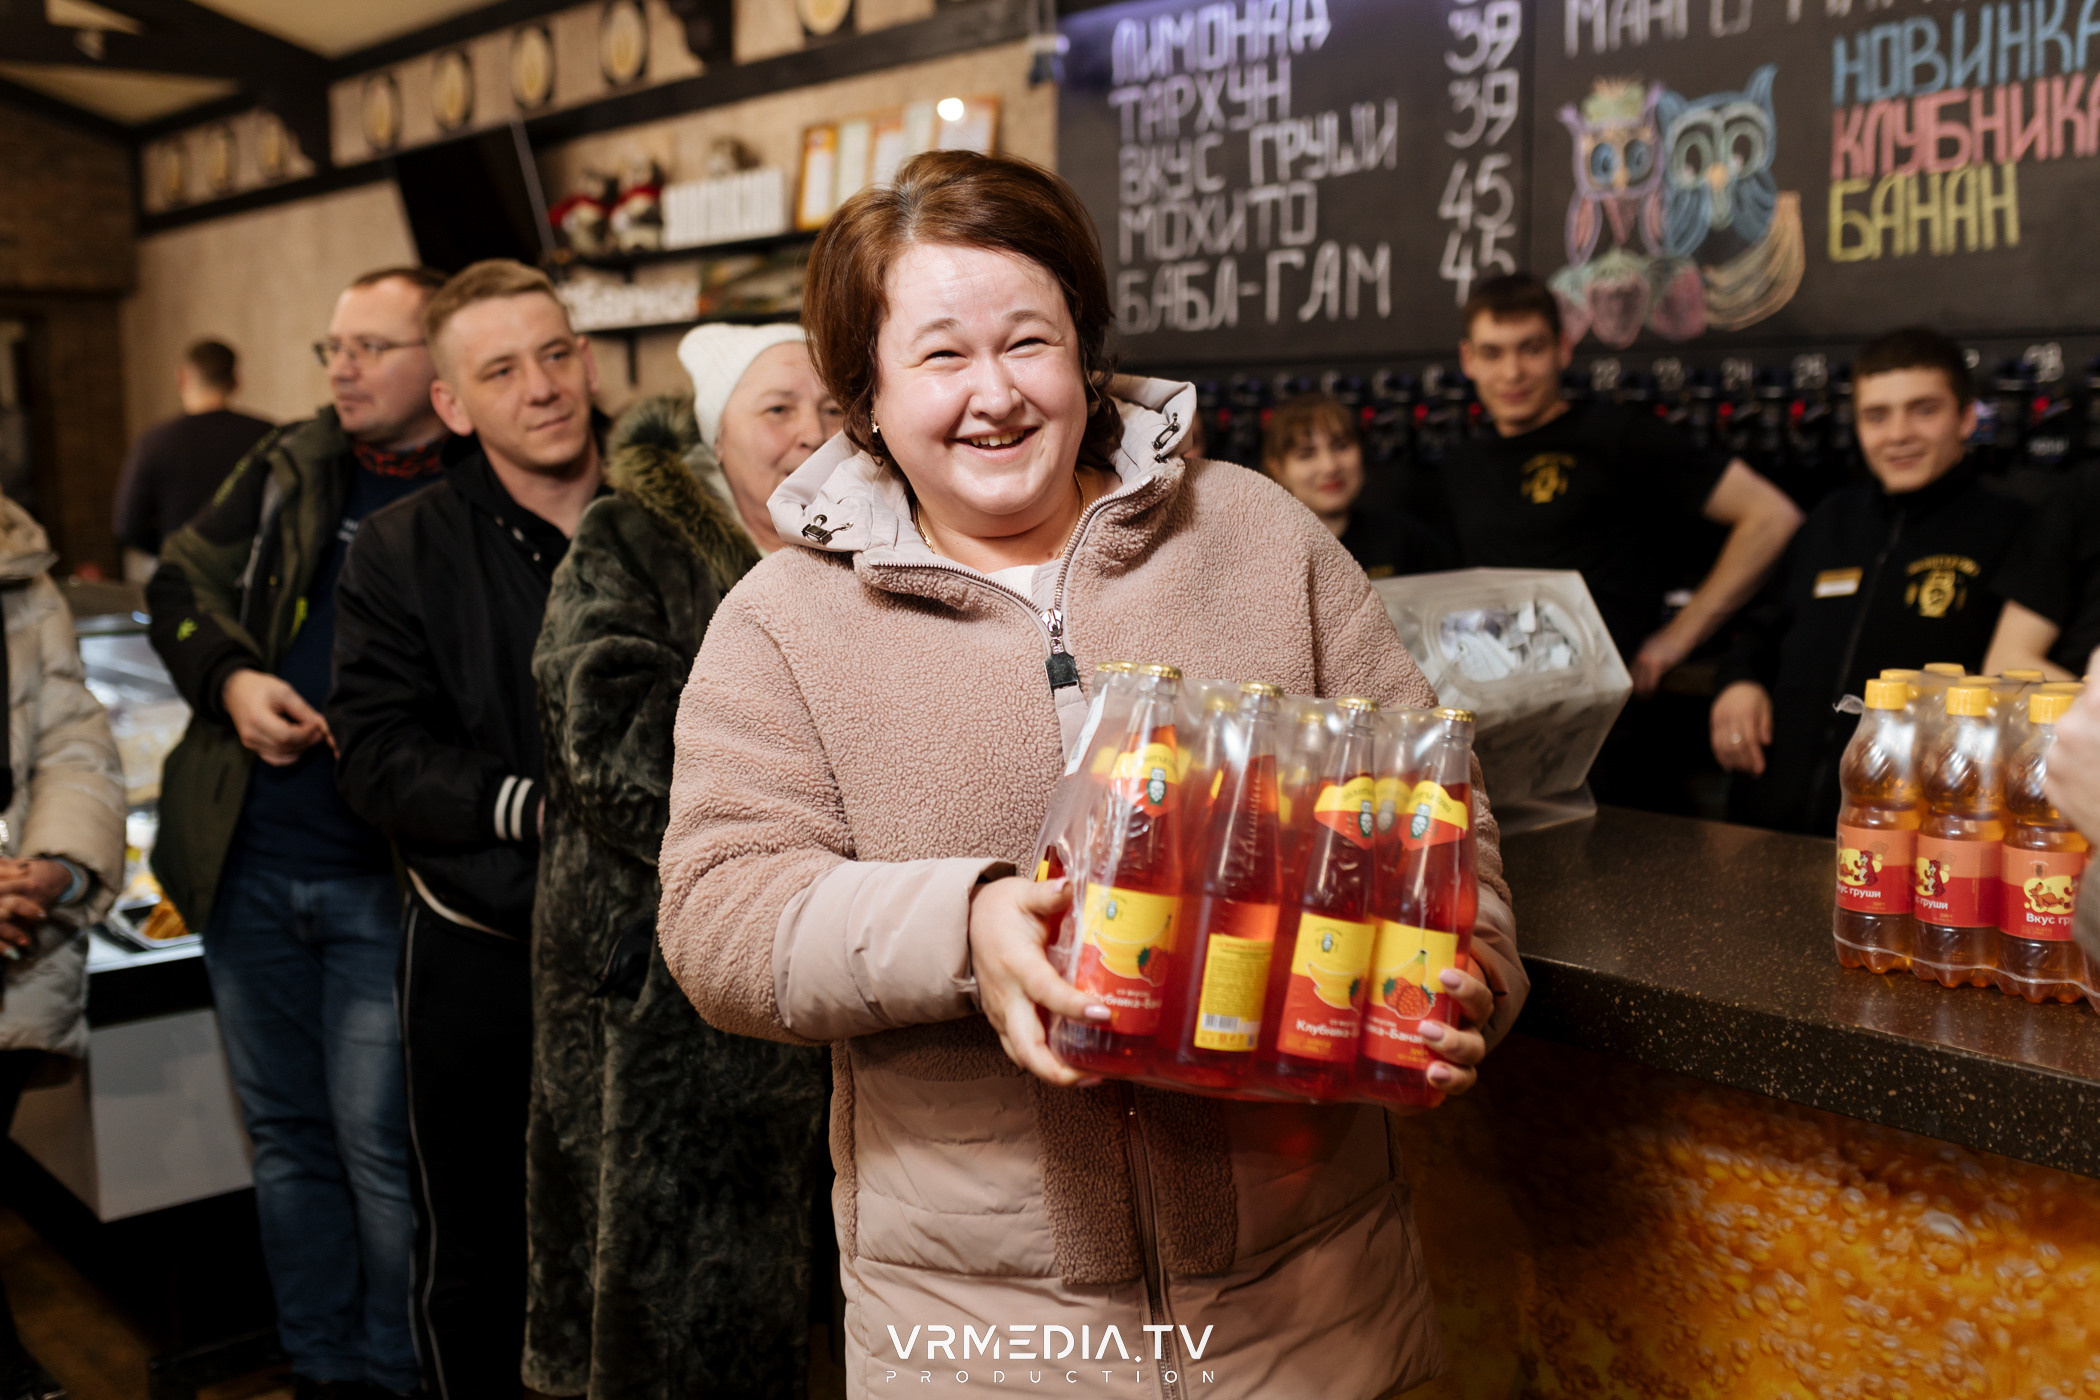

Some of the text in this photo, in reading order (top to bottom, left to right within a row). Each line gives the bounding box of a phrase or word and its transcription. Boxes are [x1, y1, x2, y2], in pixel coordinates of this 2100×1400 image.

[1112, 0, 1331, 86] ЛИМОНАД
[1444, 0, 1521, 73] 39
[1108, 56, 1290, 145] ТАРХУН
[1445, 68, 1519, 148] 39
[1119, 98, 1398, 204] ВКУС ГРУШИ
[1119, 180, 1317, 264] МОХИТО
[1438, 153, 1514, 233] 45
[1828, 158, 2020, 263] БАНАН
[1116, 241, 1391, 335] БАБЛ-ГАМ
[1849, 886, 1881, 899] груши
[1920, 897, 1949, 910] груши
[2026, 912, 2056, 926] Вкус
